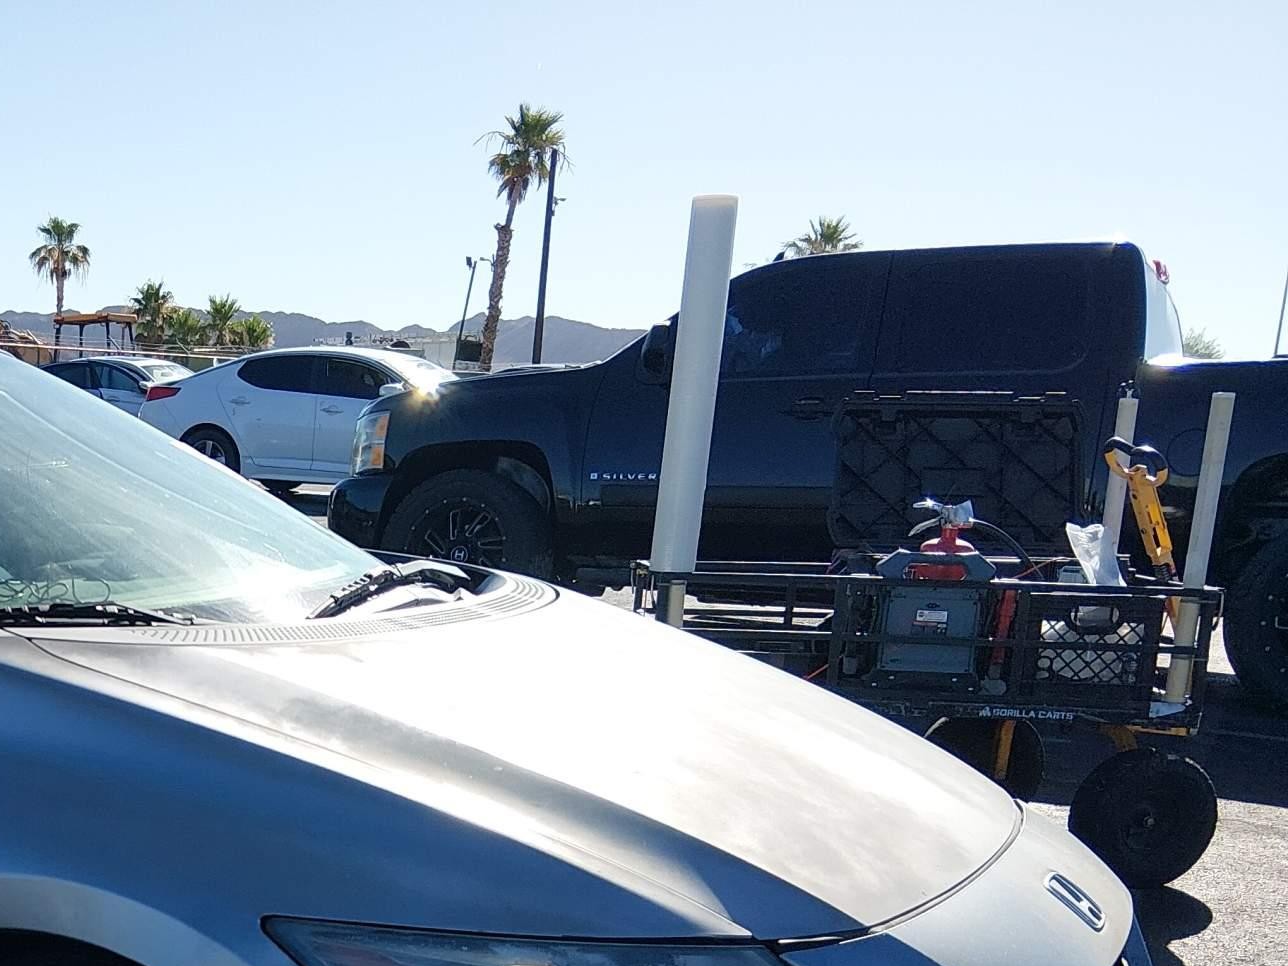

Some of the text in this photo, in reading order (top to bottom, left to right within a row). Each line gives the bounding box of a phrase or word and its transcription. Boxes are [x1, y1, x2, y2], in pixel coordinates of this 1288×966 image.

[602, 472, 657, 480] SILVER
[992, 708, 1074, 720] GORILLA CARTS
